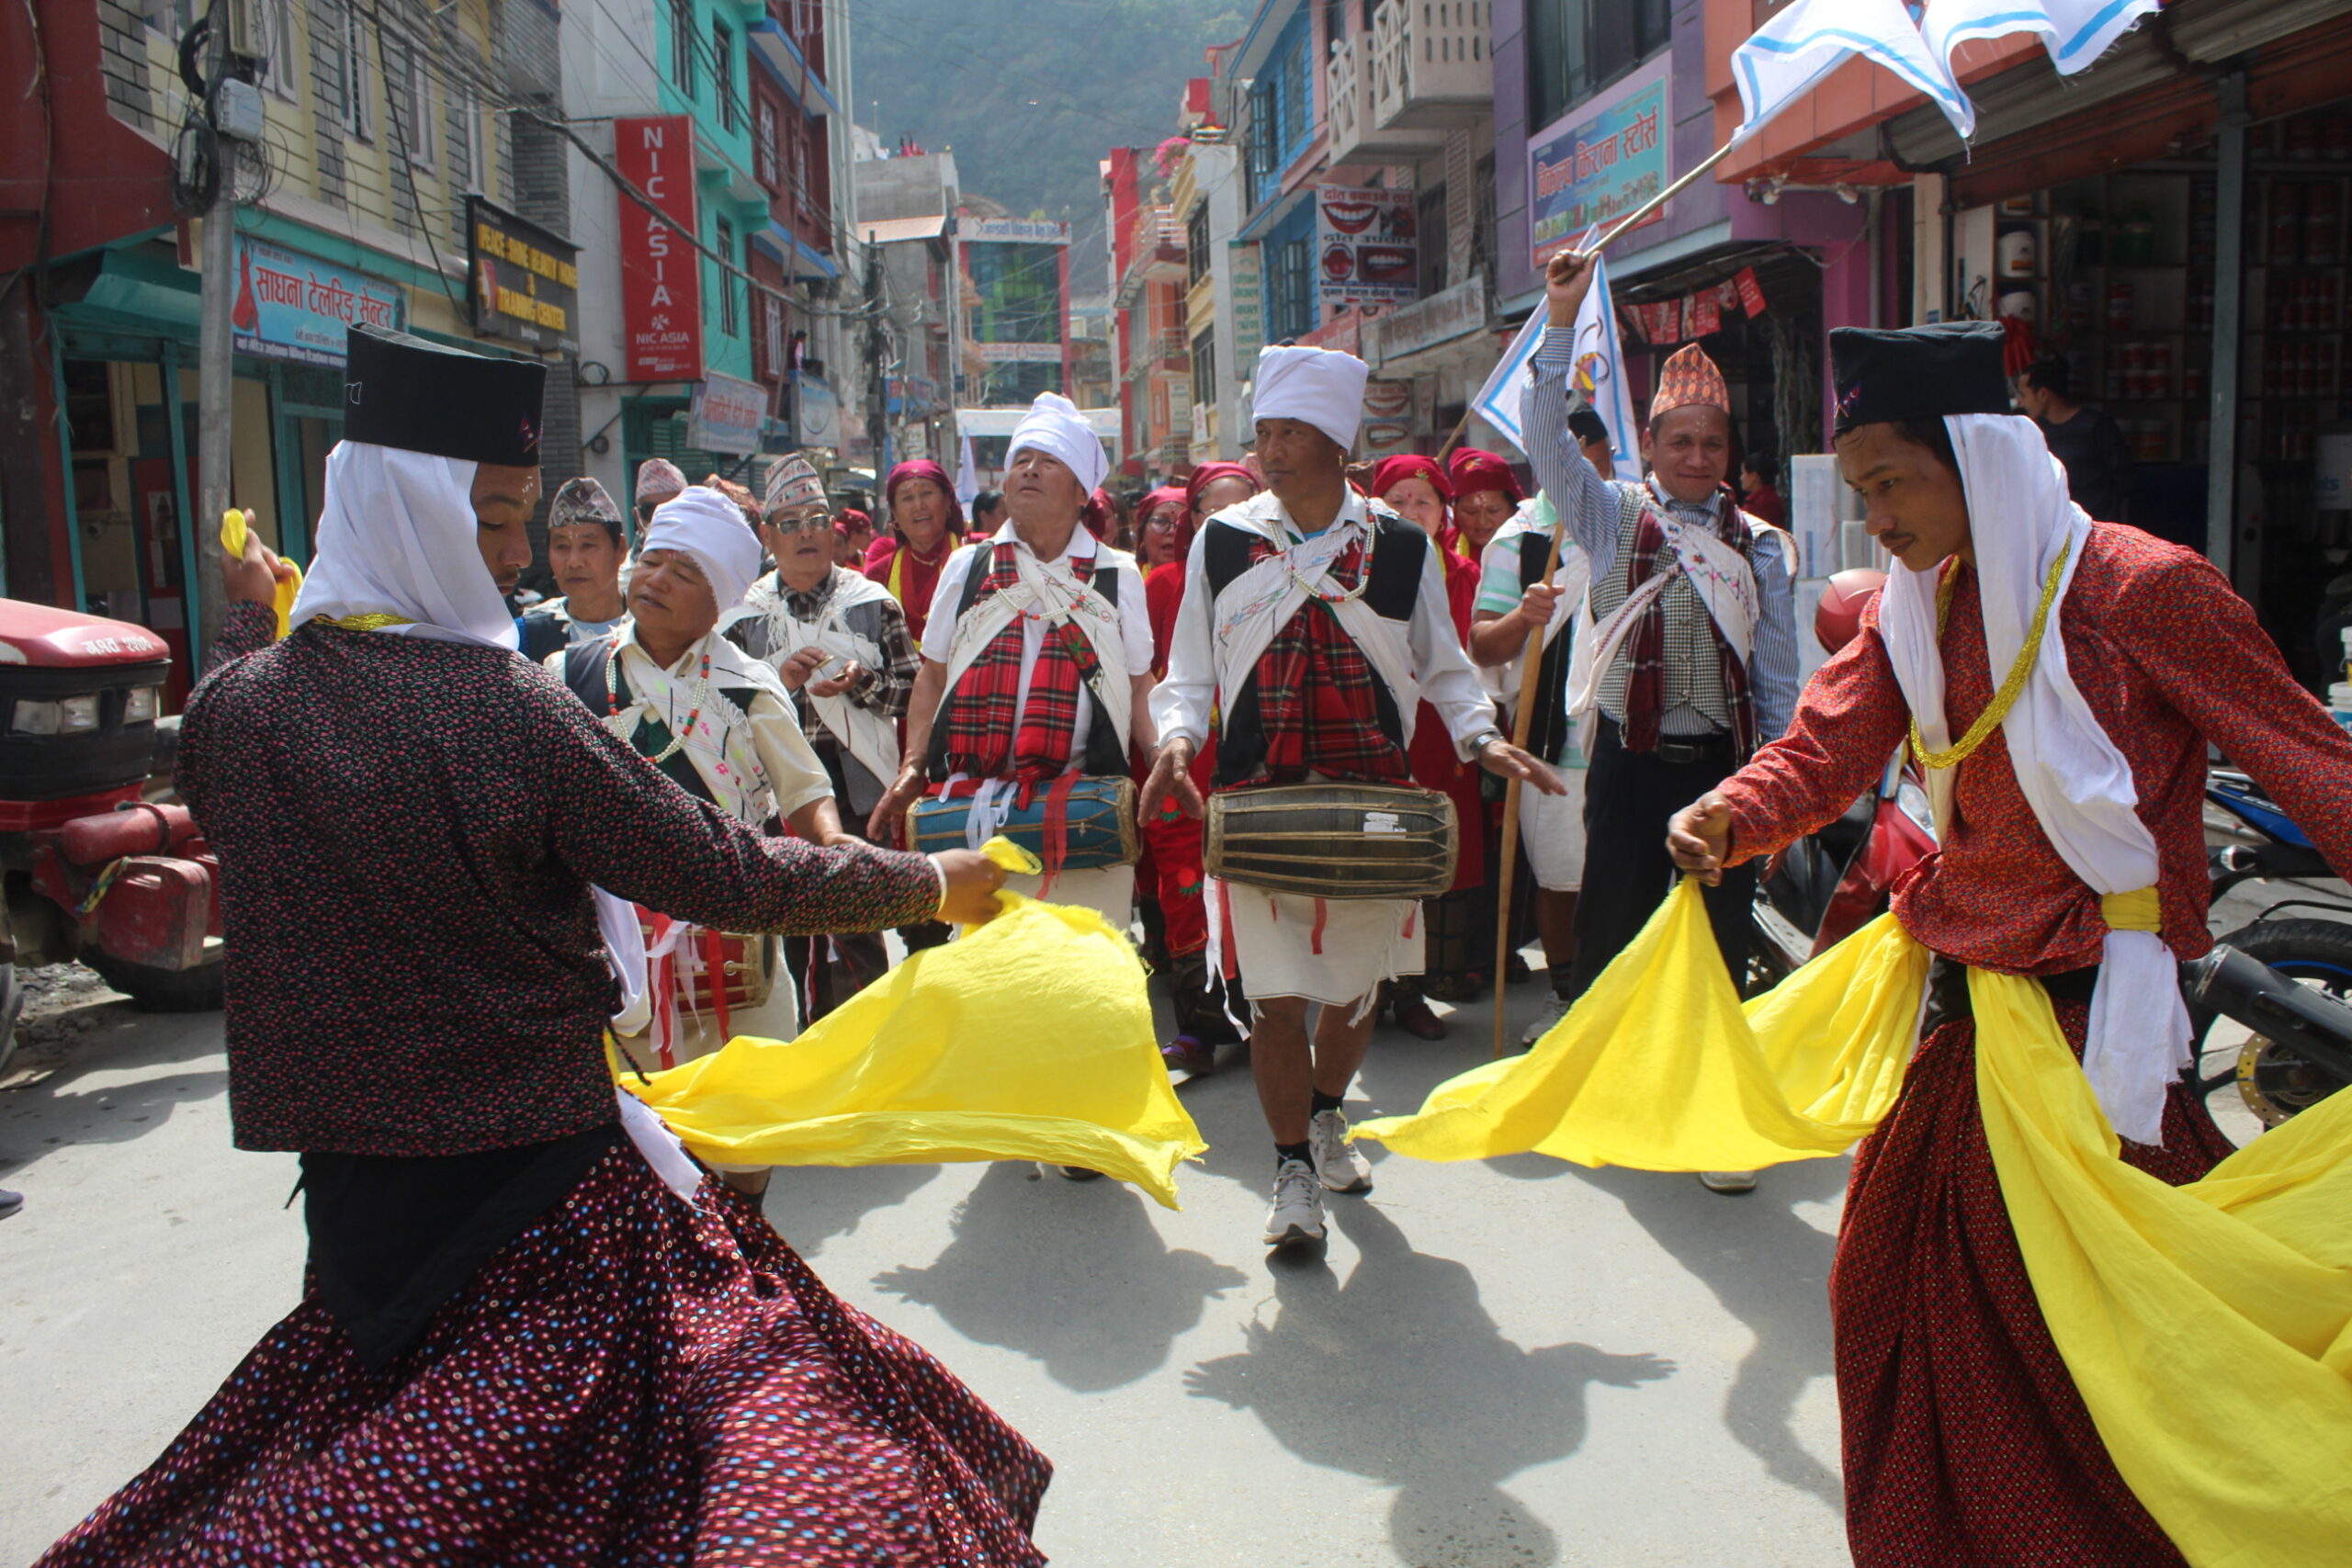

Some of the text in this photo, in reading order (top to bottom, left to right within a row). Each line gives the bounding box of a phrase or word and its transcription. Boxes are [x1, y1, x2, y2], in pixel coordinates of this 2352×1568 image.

[644, 127, 664, 197] NIC
[529, 247, 558, 280] BEAUTY
[647, 215, 673, 306] ASIA
[255, 266, 303, 309] साधना
[497, 286, 566, 332] TRAINING CENTER
[636, 332, 690, 344] NIC ASIA
